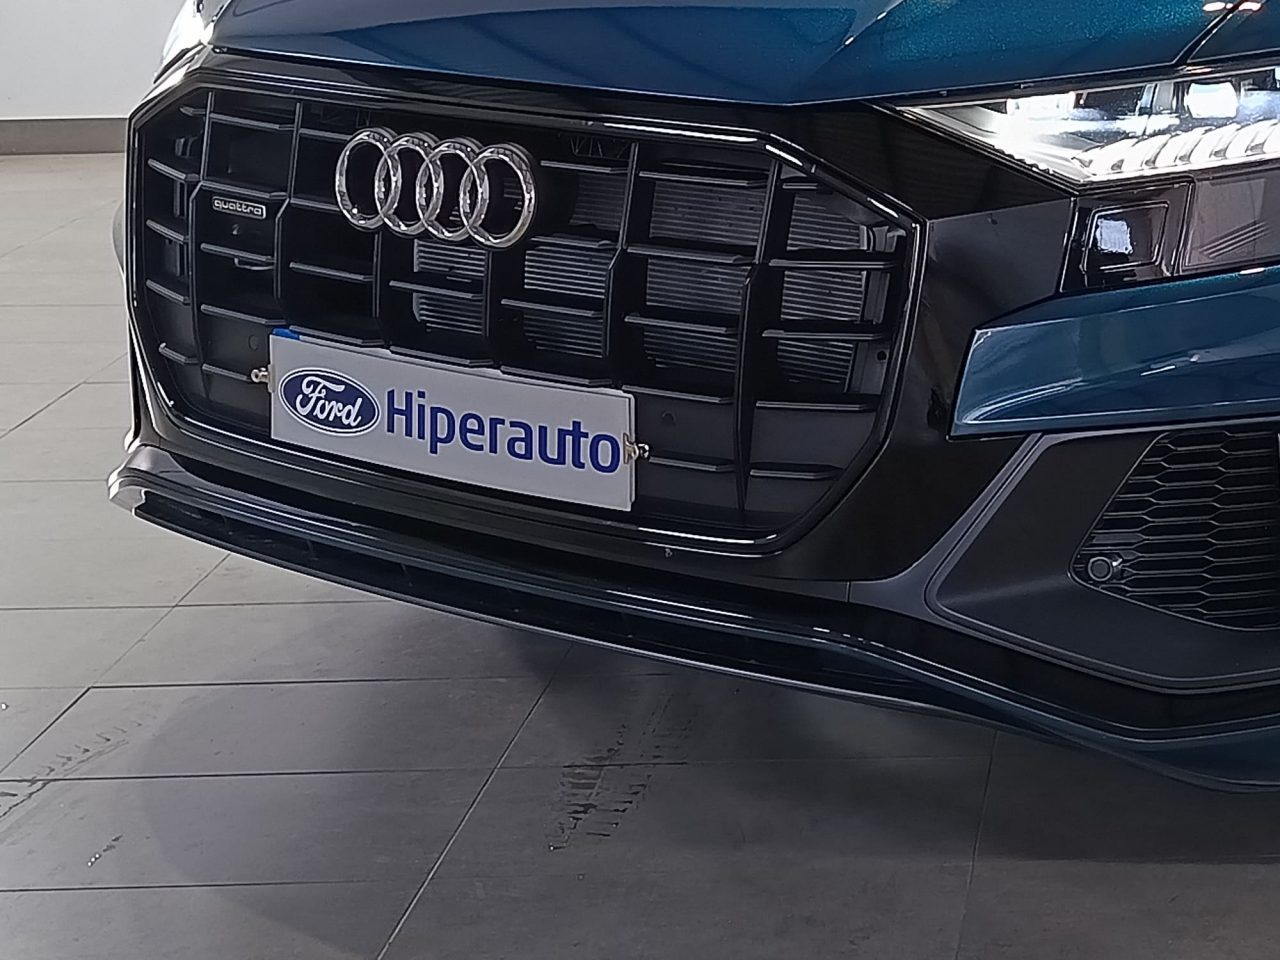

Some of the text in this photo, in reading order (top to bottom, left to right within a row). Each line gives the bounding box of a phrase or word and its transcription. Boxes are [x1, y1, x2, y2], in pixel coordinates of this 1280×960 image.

[214, 199, 262, 215] quattro
[295, 375, 622, 473] Ford Hiperauto
